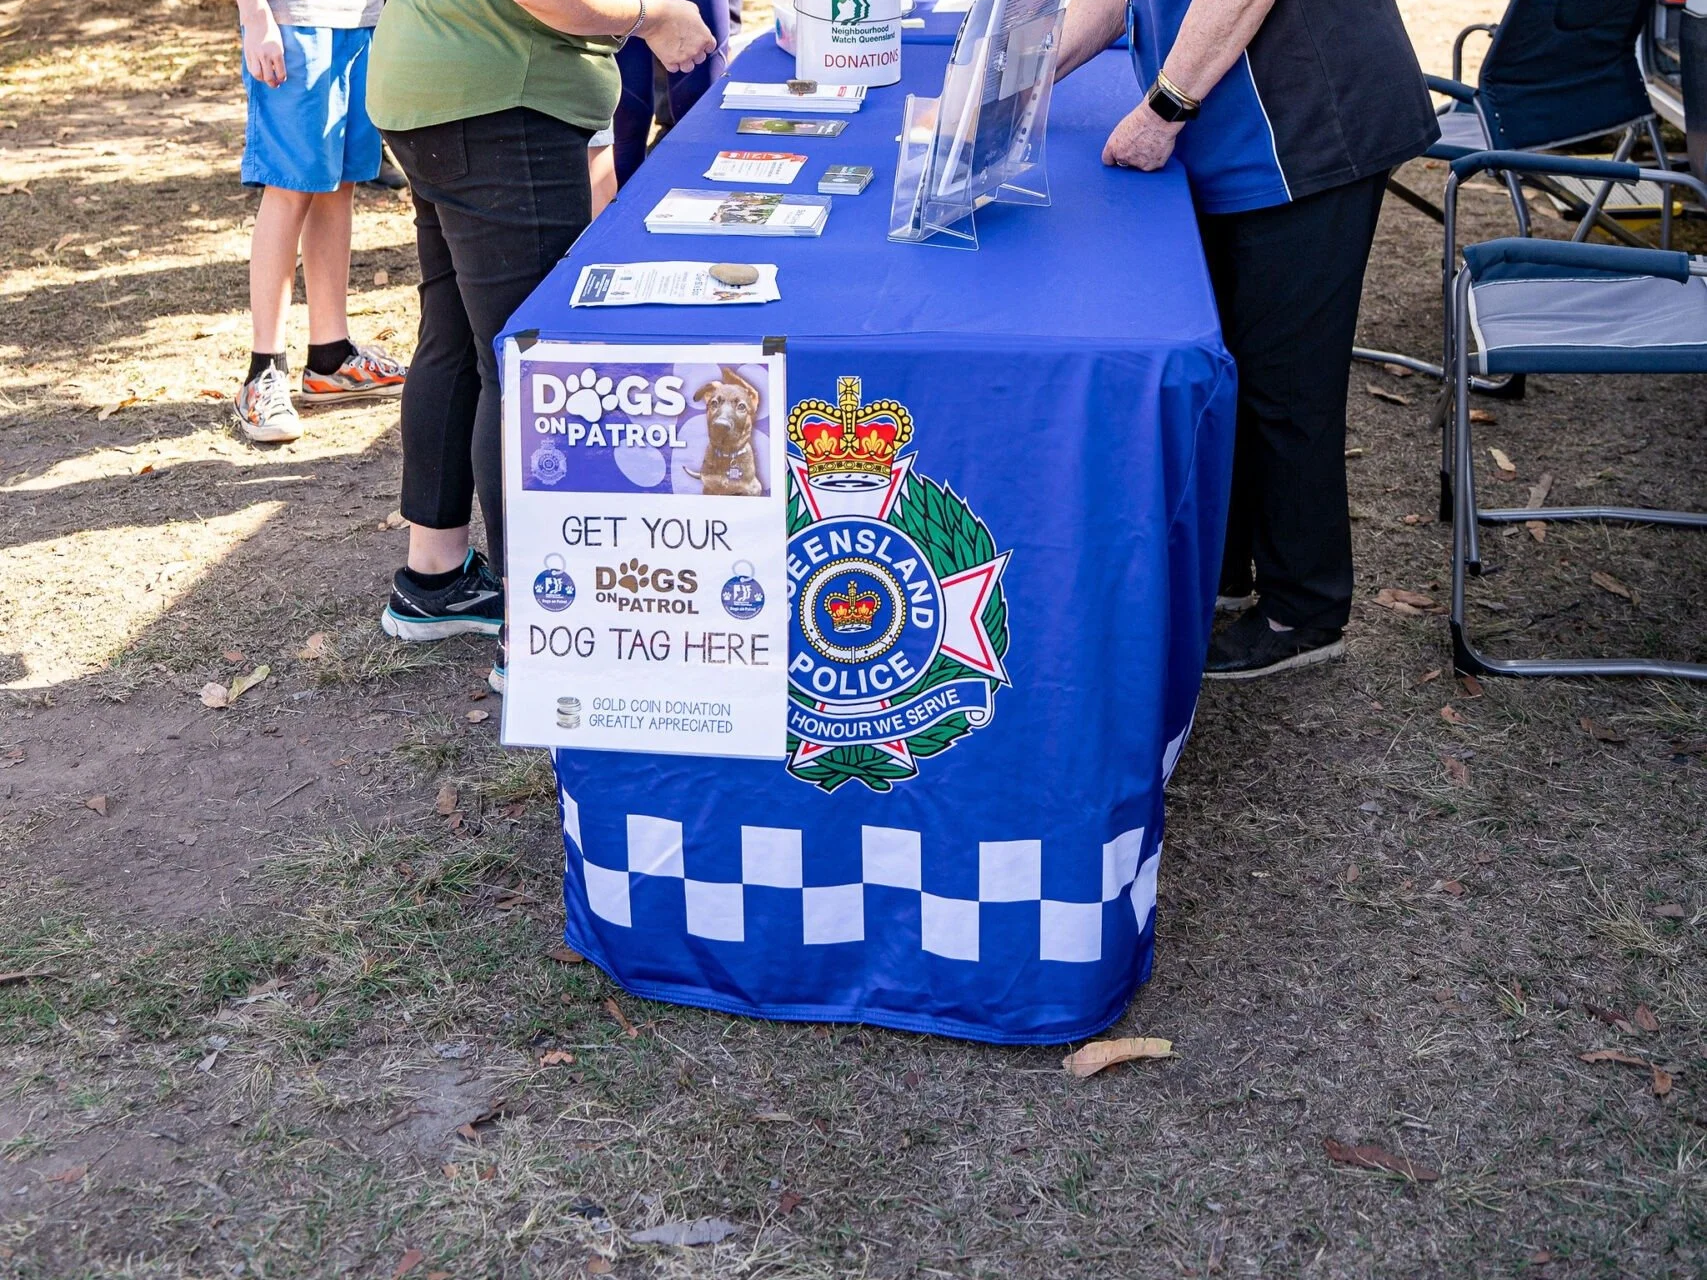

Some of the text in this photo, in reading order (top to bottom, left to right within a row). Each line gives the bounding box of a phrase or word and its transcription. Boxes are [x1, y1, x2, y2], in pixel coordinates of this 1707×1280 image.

[831, 24, 889, 36] Neighbourhood
[831, 32, 896, 43] Watch Queensland
[824, 48, 899, 68] DONATIONS
[534, 416, 687, 448] ON PATROL
[562, 516, 732, 551] GET YOUR
[595, 592, 699, 615] ON PATROL
[529, 625, 769, 666] DOG TAG HERE
[788, 650, 916, 696] POLICE
[592, 697, 731, 717] GOLD COIN DONATION
[791, 688, 961, 738] HONOUR WE SERVE
[589, 713, 733, 734] GREATLY APPRECIATED
